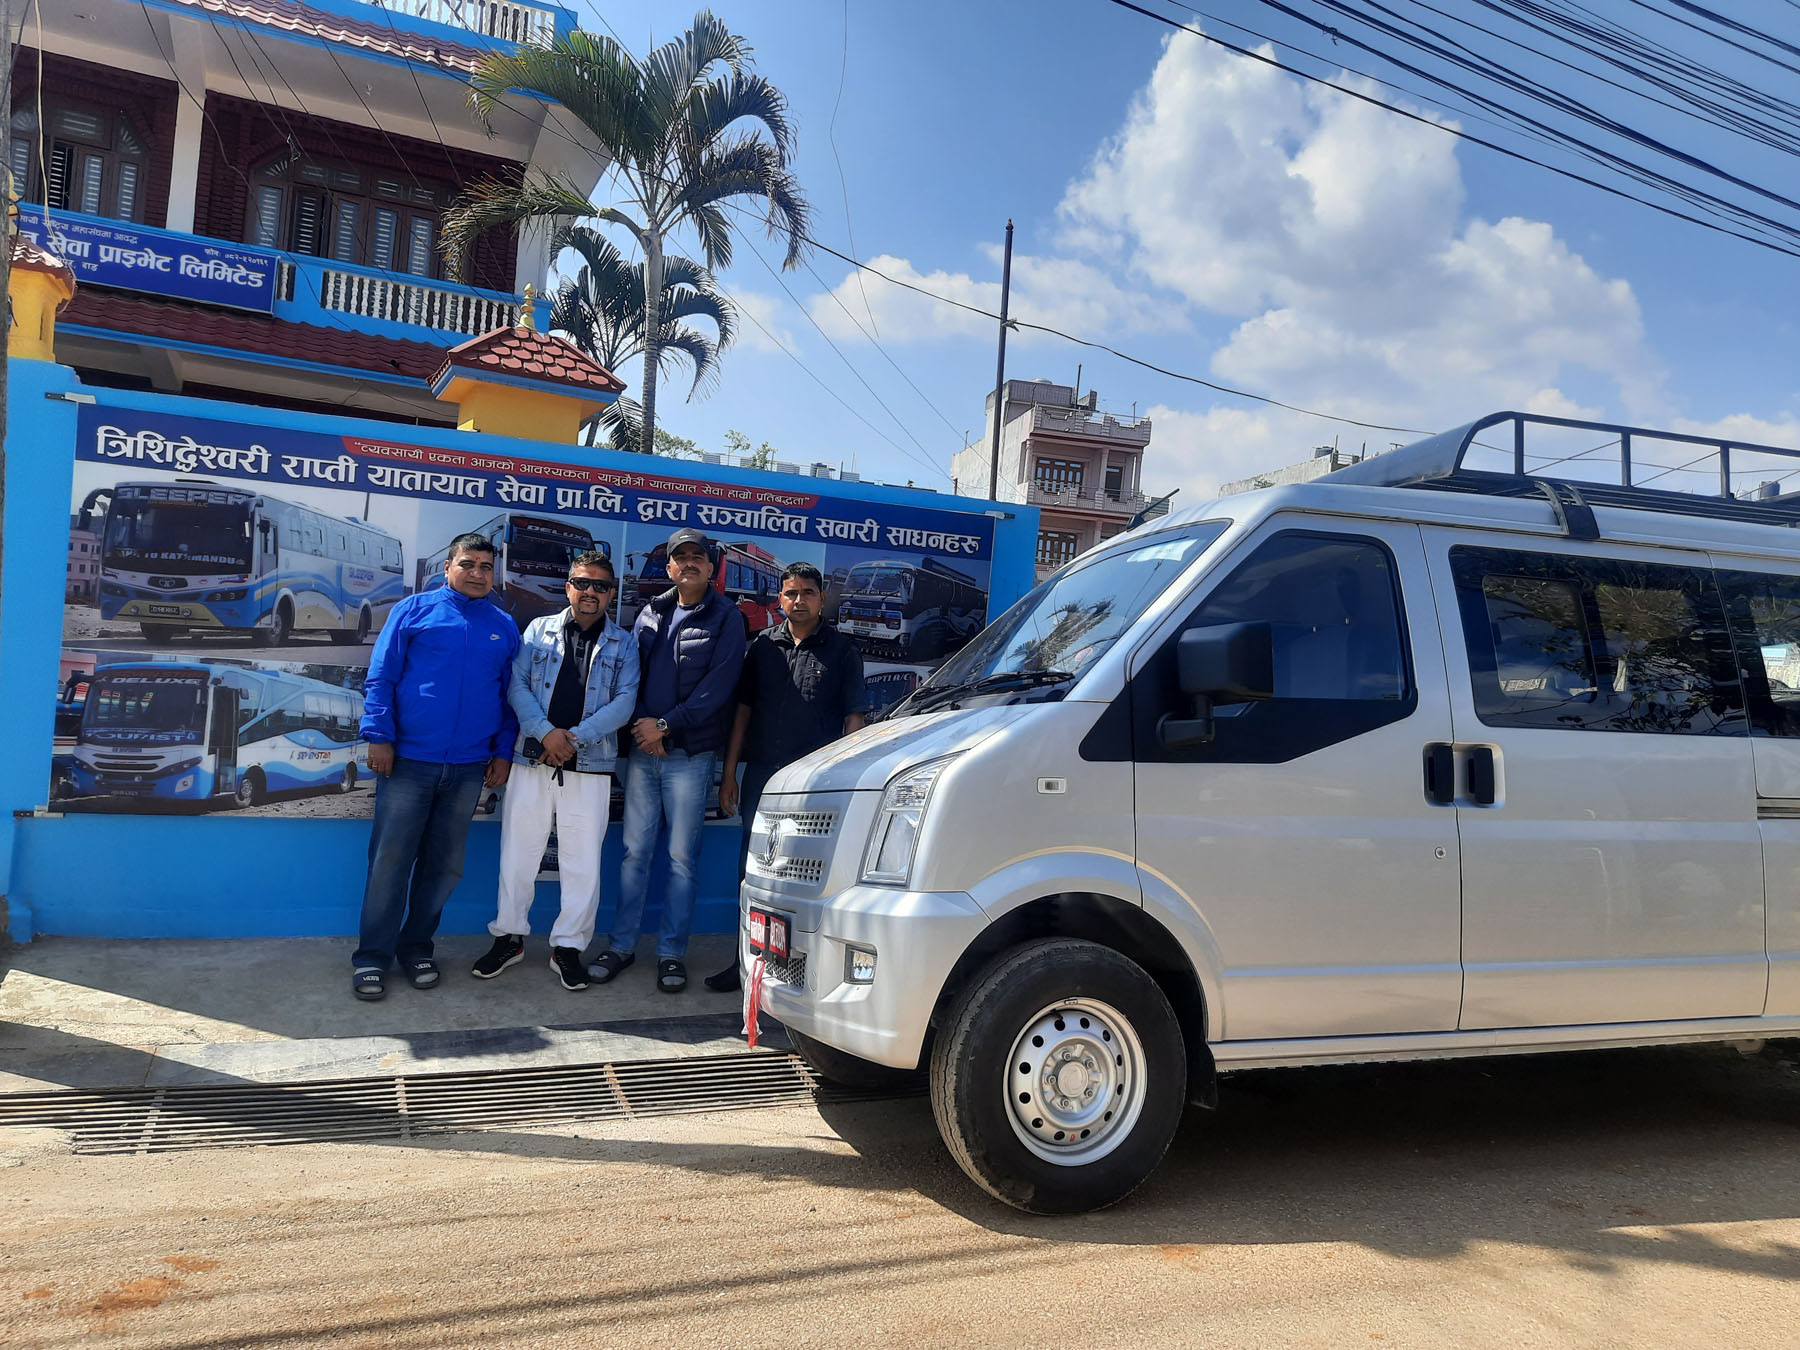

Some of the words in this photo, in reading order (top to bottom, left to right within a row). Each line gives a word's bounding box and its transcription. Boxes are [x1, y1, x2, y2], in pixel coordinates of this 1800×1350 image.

[46, 231, 92, 258] सेवा
[99, 244, 174, 273] प्राइभेट
[179, 254, 266, 288] लिमिटेड
[117, 487, 248, 505] SLEEPER
[428, 451, 466, 466] एकता
[470, 456, 516, 473] आजको
[649, 479, 698, 493] यातायात
[701, 484, 724, 497] सेवा
[281, 455, 358, 484] राप्ती
[368, 465, 488, 499] यातायात
[495, 475, 548, 505] सेवा
[556, 483, 629, 514] प्रा.लि.
[637, 496, 691, 522] द्वारा
[697, 500, 809, 535] सञ्चालित
[815, 516, 881, 544] सवारी
[111, 677, 202, 688] DELUXE
